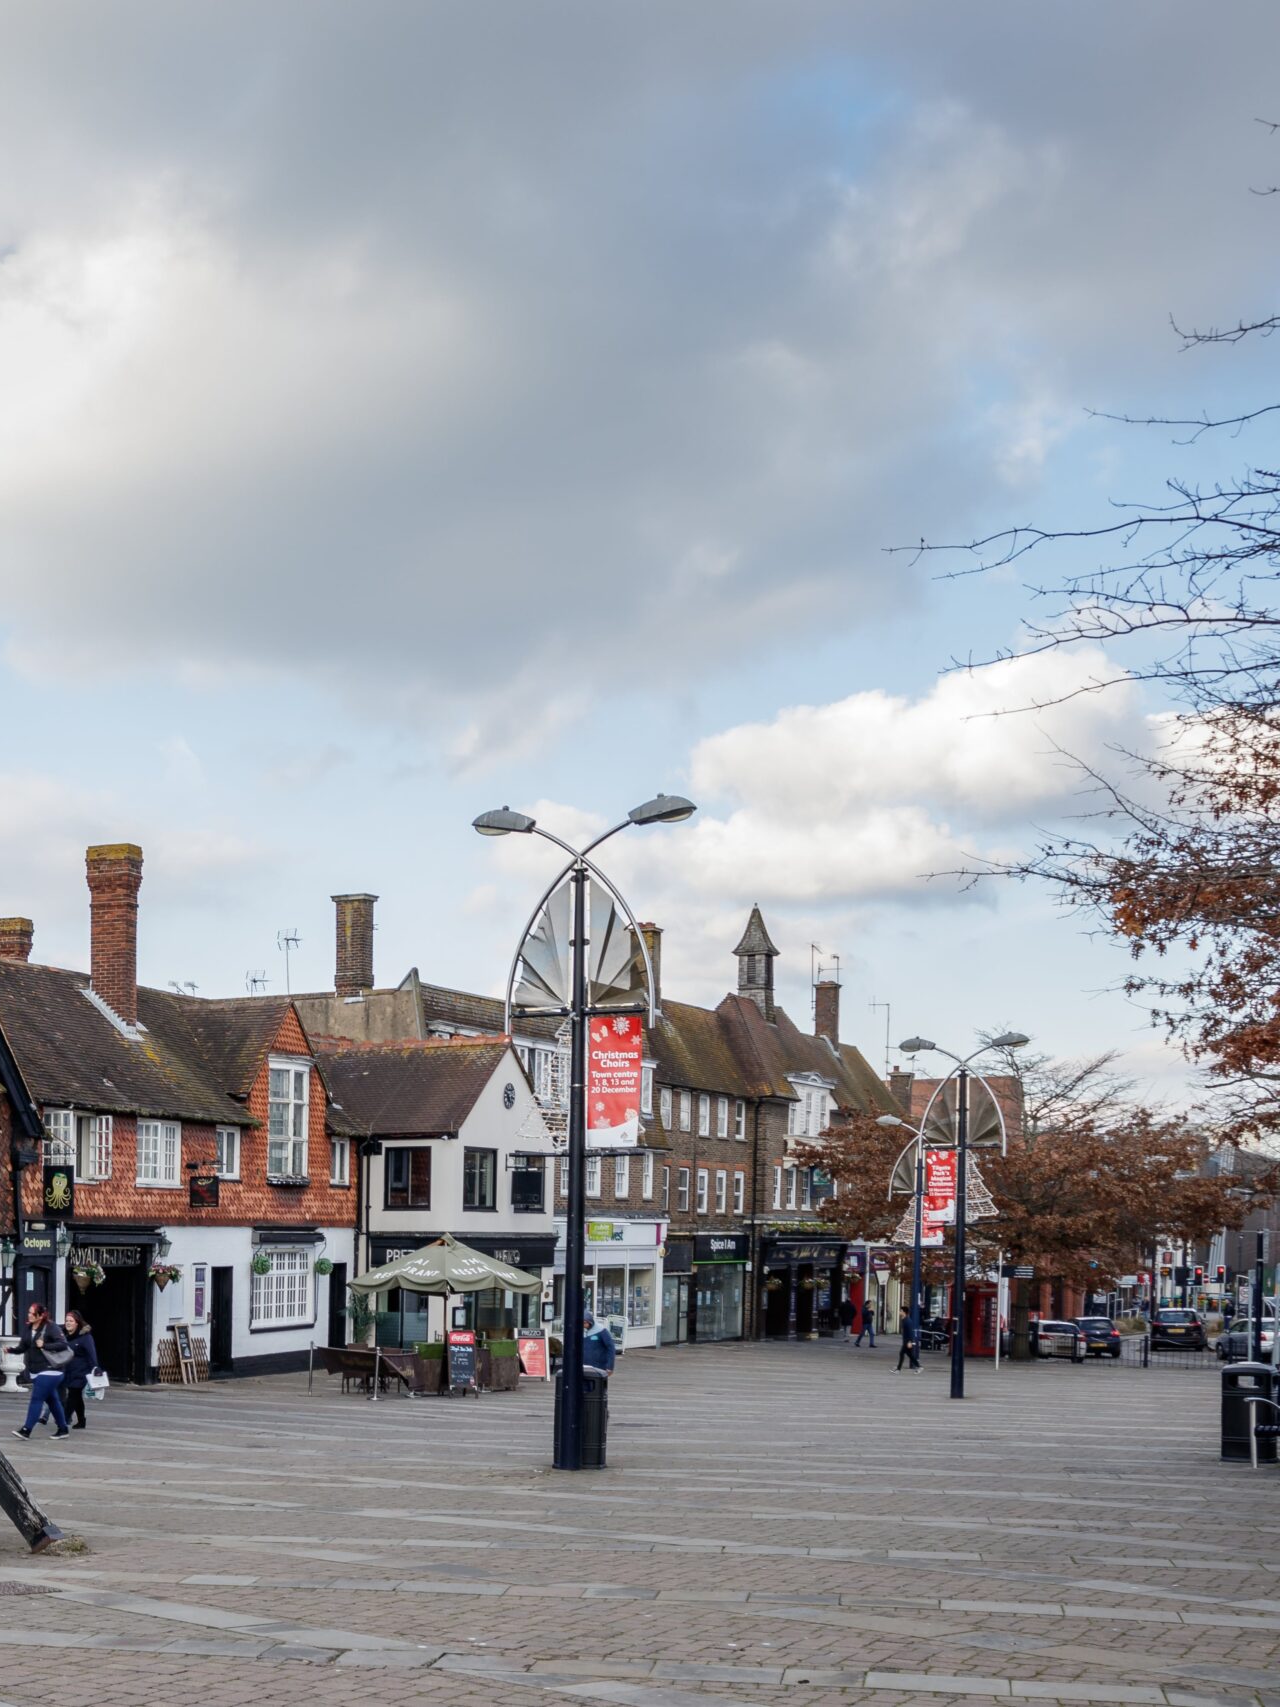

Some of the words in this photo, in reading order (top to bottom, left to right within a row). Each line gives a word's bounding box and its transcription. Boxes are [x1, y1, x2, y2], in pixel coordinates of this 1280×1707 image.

[592, 1051, 639, 1059] Christmas
[710, 1238, 724, 1252] Spice
[727, 1239, 736, 1249] Am
[70, 1247, 97, 1265] ROYAL
